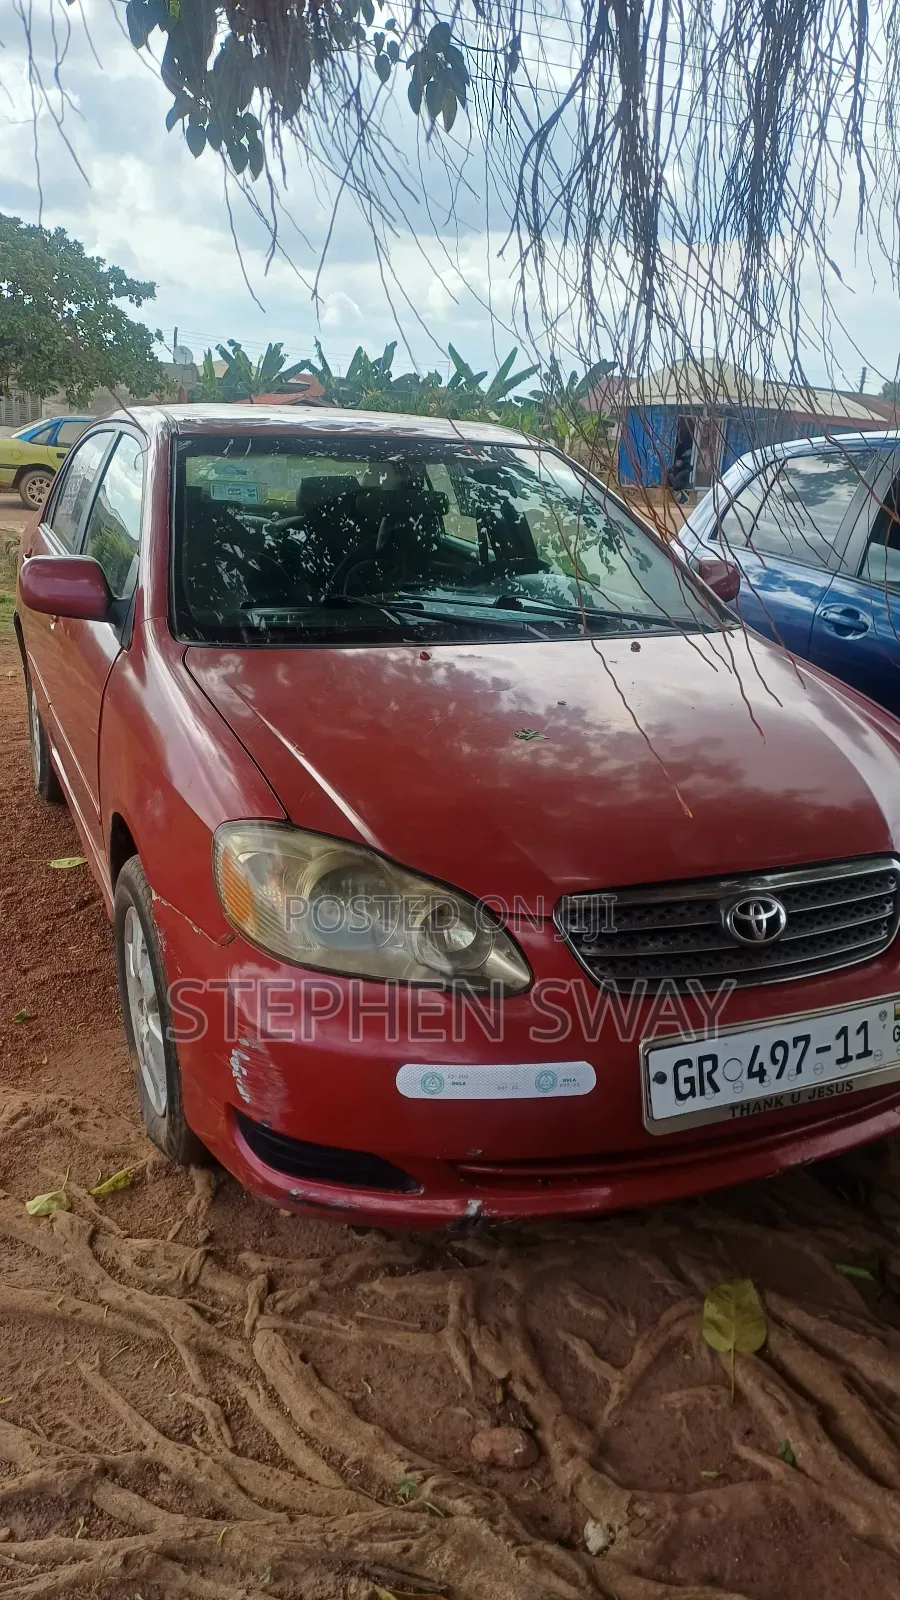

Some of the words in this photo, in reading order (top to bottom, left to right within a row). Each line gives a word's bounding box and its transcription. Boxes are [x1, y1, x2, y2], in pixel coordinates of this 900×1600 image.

[672, 1053, 721, 1102] GR
[747, 1020, 874, 1085] 497-11
[729, 1096, 784, 1118] THANK
[790, 1090, 802, 1105] U
[808, 1080, 854, 1101] JESUS
